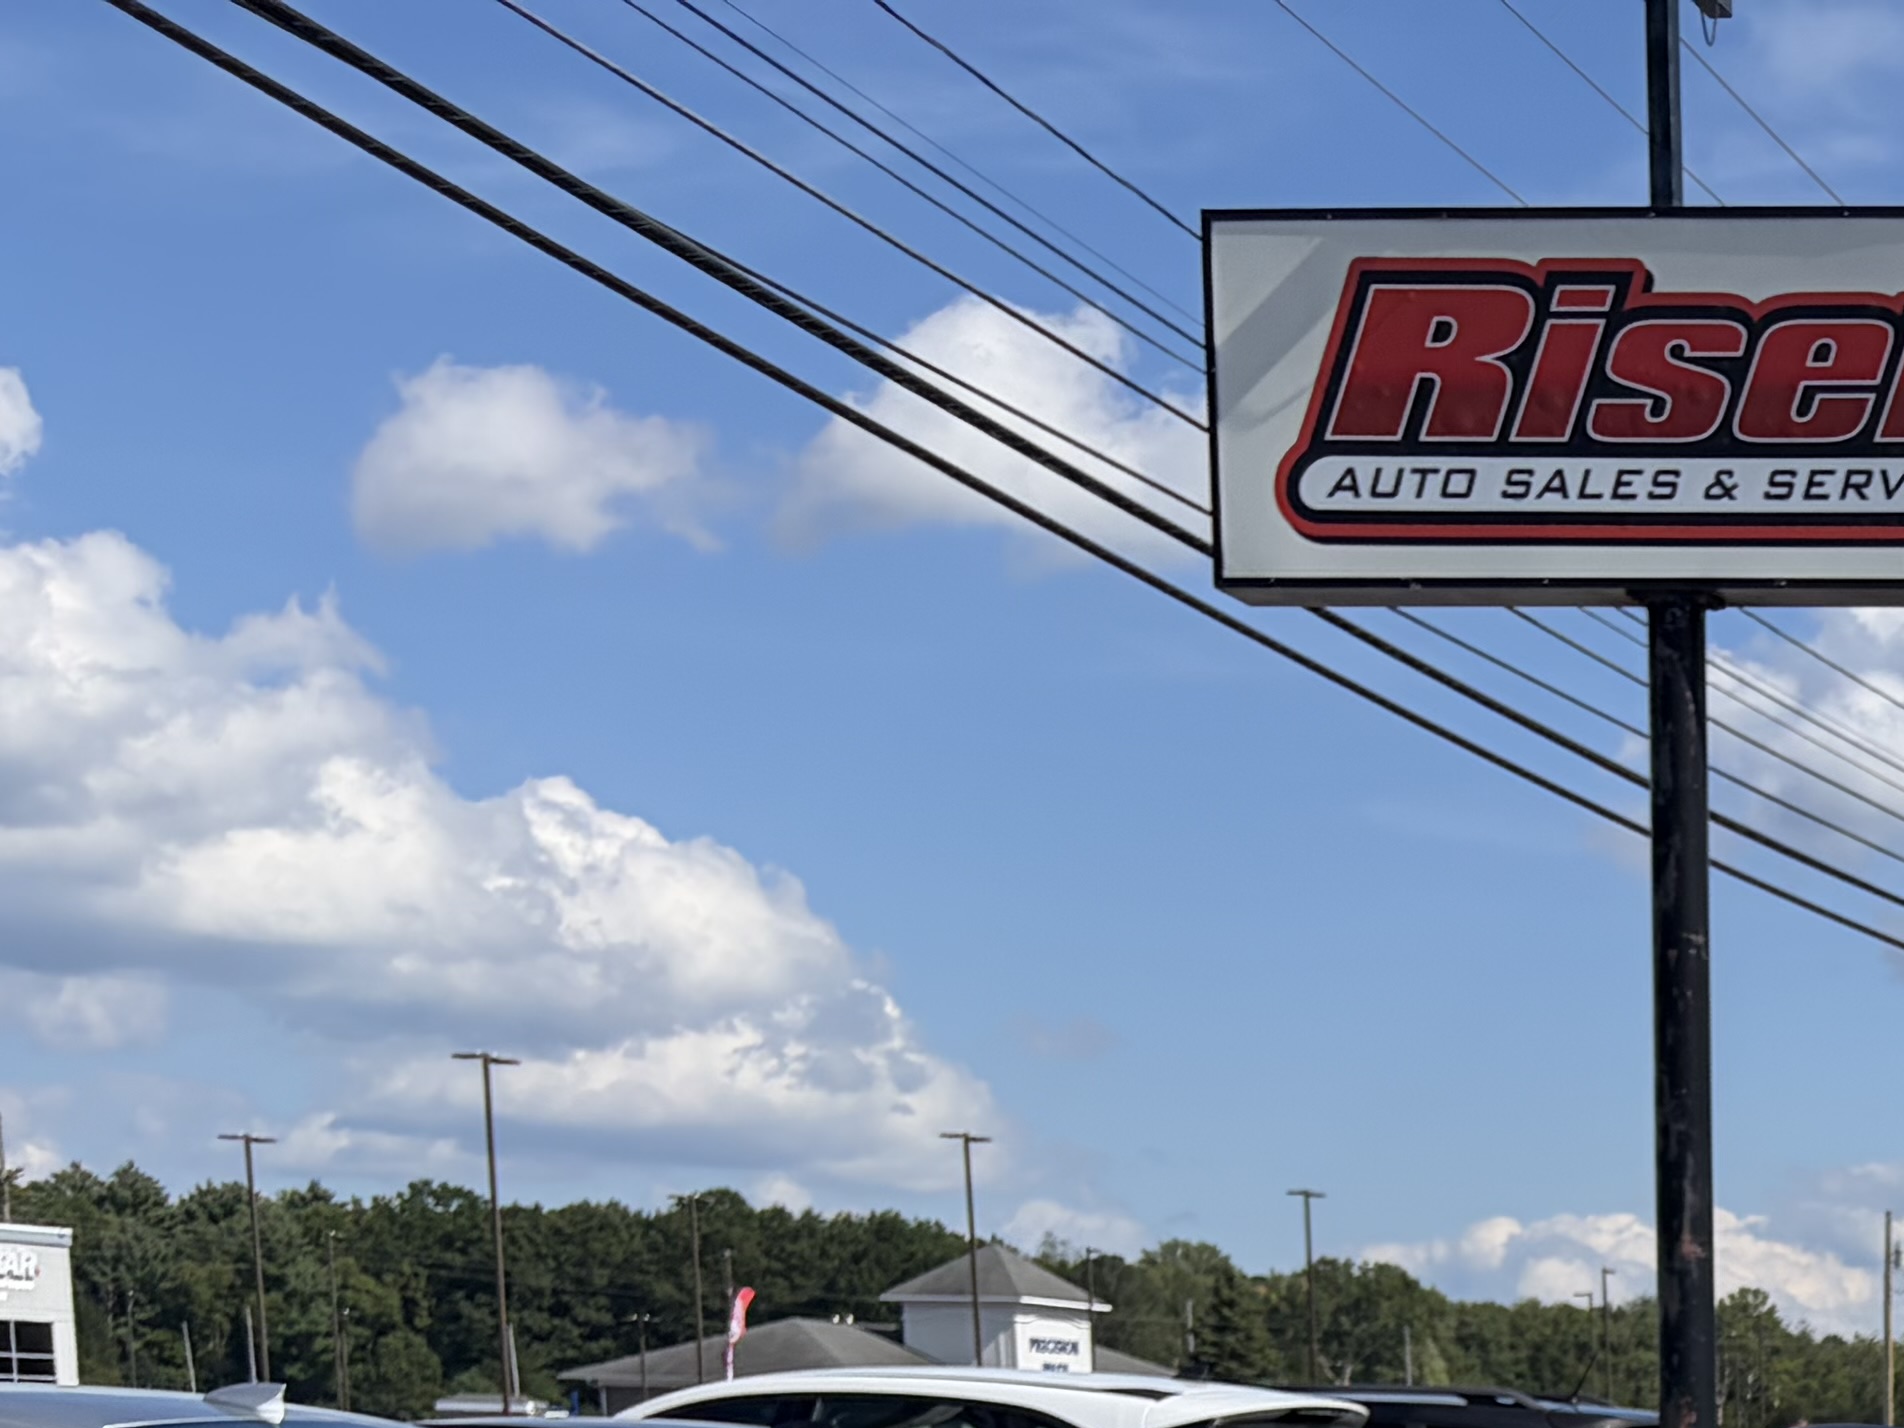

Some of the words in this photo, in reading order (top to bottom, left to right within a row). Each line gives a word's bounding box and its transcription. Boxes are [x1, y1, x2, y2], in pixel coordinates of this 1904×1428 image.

[1326, 466, 1477, 499] AUTO
[1500, 468, 1682, 501] SALES
[1703, 469, 1740, 501] &
